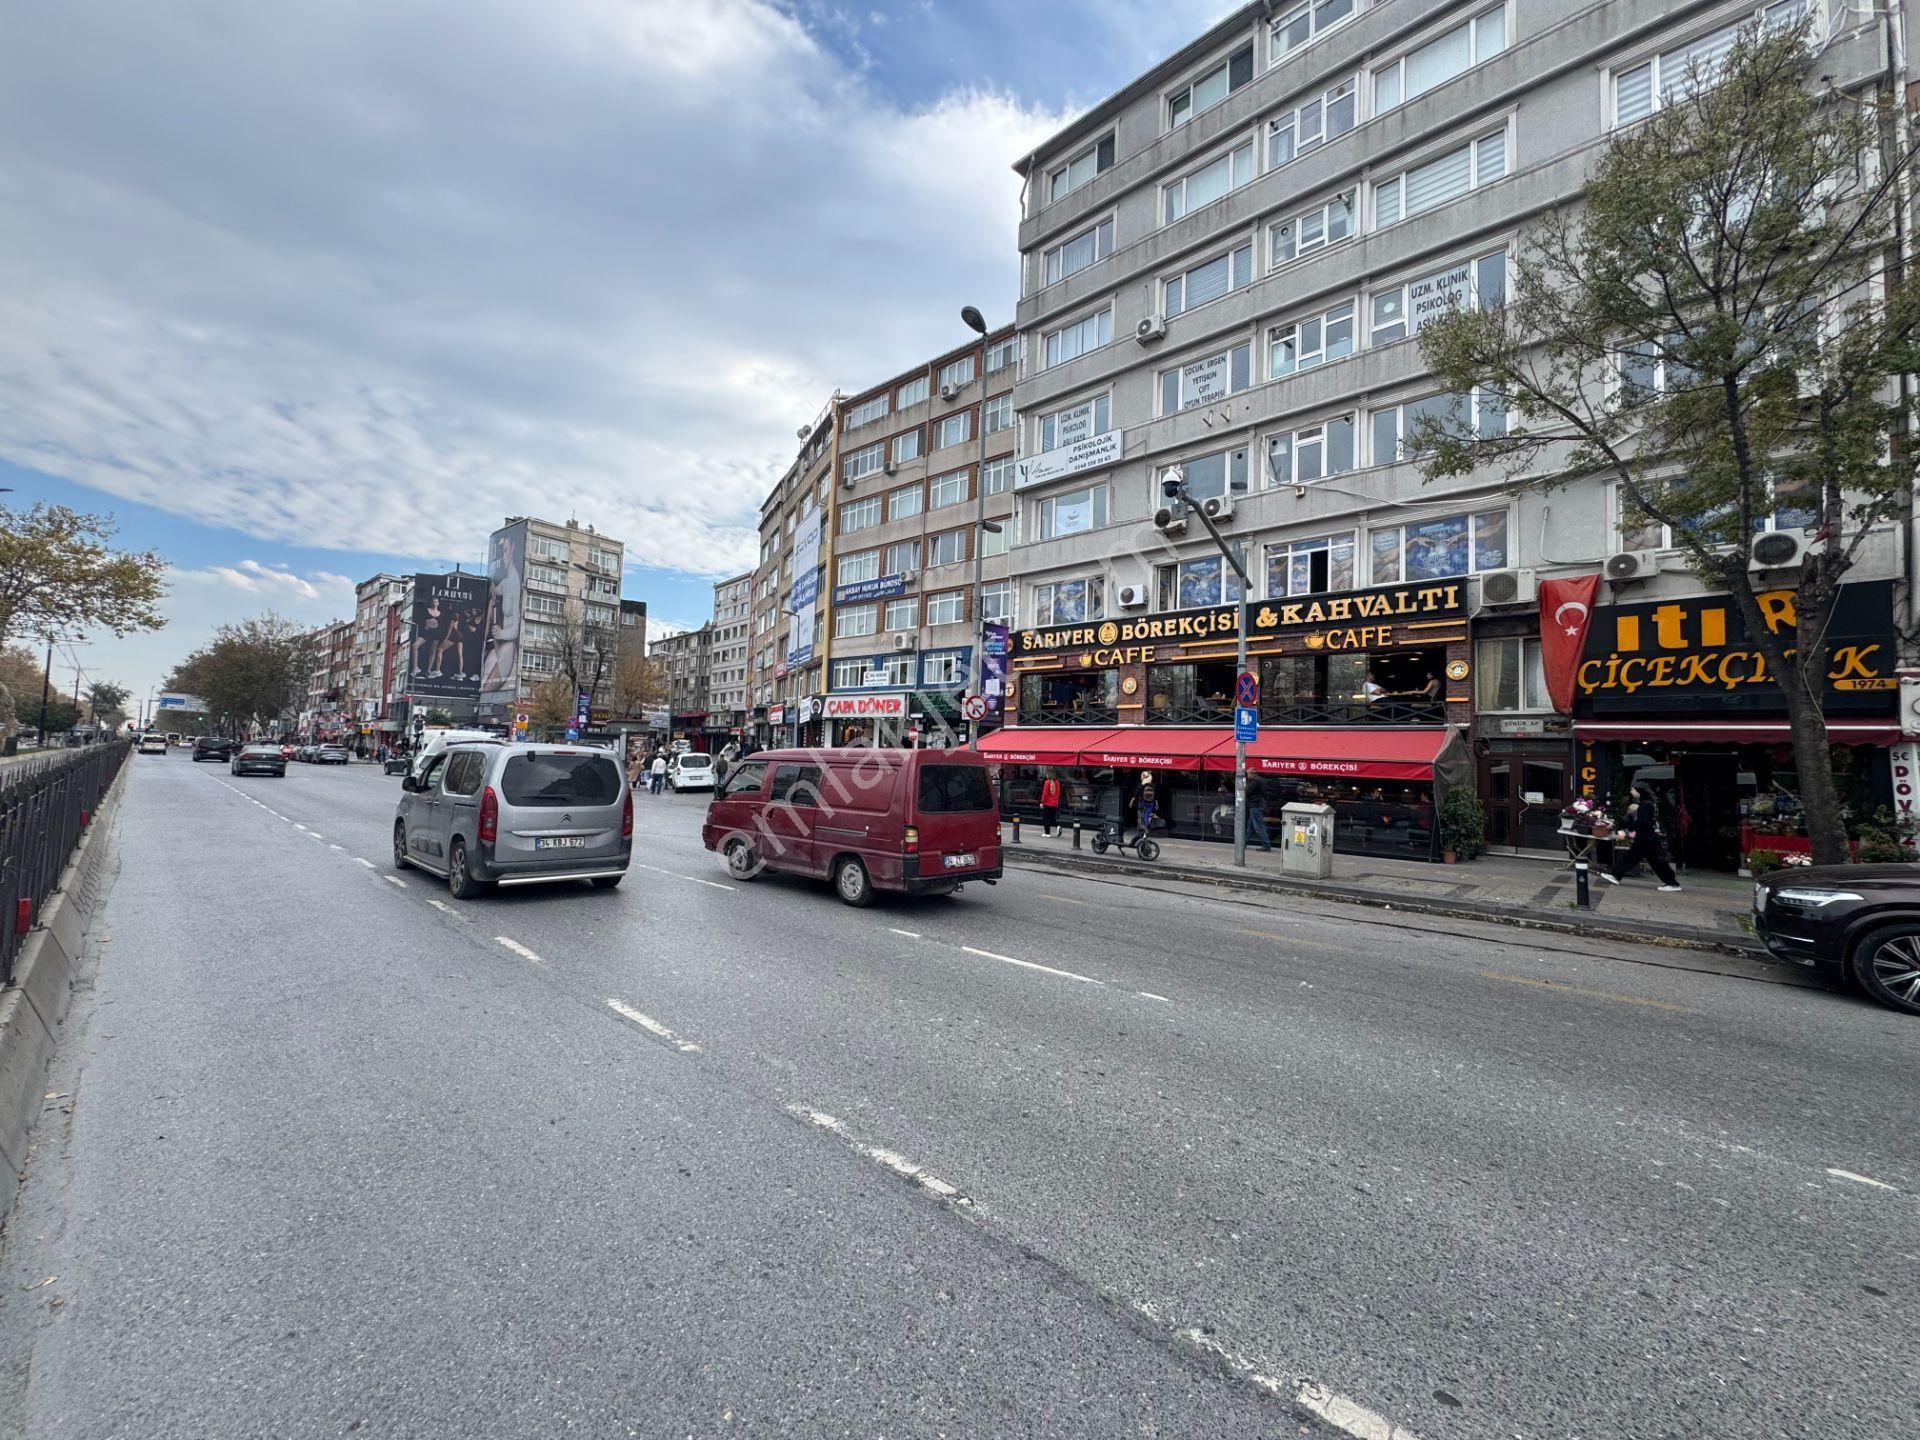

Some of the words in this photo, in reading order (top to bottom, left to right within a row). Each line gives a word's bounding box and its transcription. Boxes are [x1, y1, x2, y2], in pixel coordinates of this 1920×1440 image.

[1411, 283, 1434, 299] UZM.
[1436, 268, 1468, 290] KLİNİK
[1416, 290, 1462, 314] PSİKOLOG
[1069, 443, 1117, 464] DANIŞMANLIK
[1073, 434, 1112, 453] PSİKOLOJİK
[1022, 629, 1095, 650] SARIYER
[1122, 607, 1239, 640] BÖREKÇİSİ
[1326, 626, 1394, 650] CAFE
[1094, 645, 1156, 666] CAFE
[1851, 680, 1888, 689] 1974
[858, 697, 902, 714] DÖNER
[1138, 756, 1172, 765] BÖREKÇİSİ
[1310, 762, 1358, 771] BÖREKÇİSİ
[540, 839, 550, 848] 34
